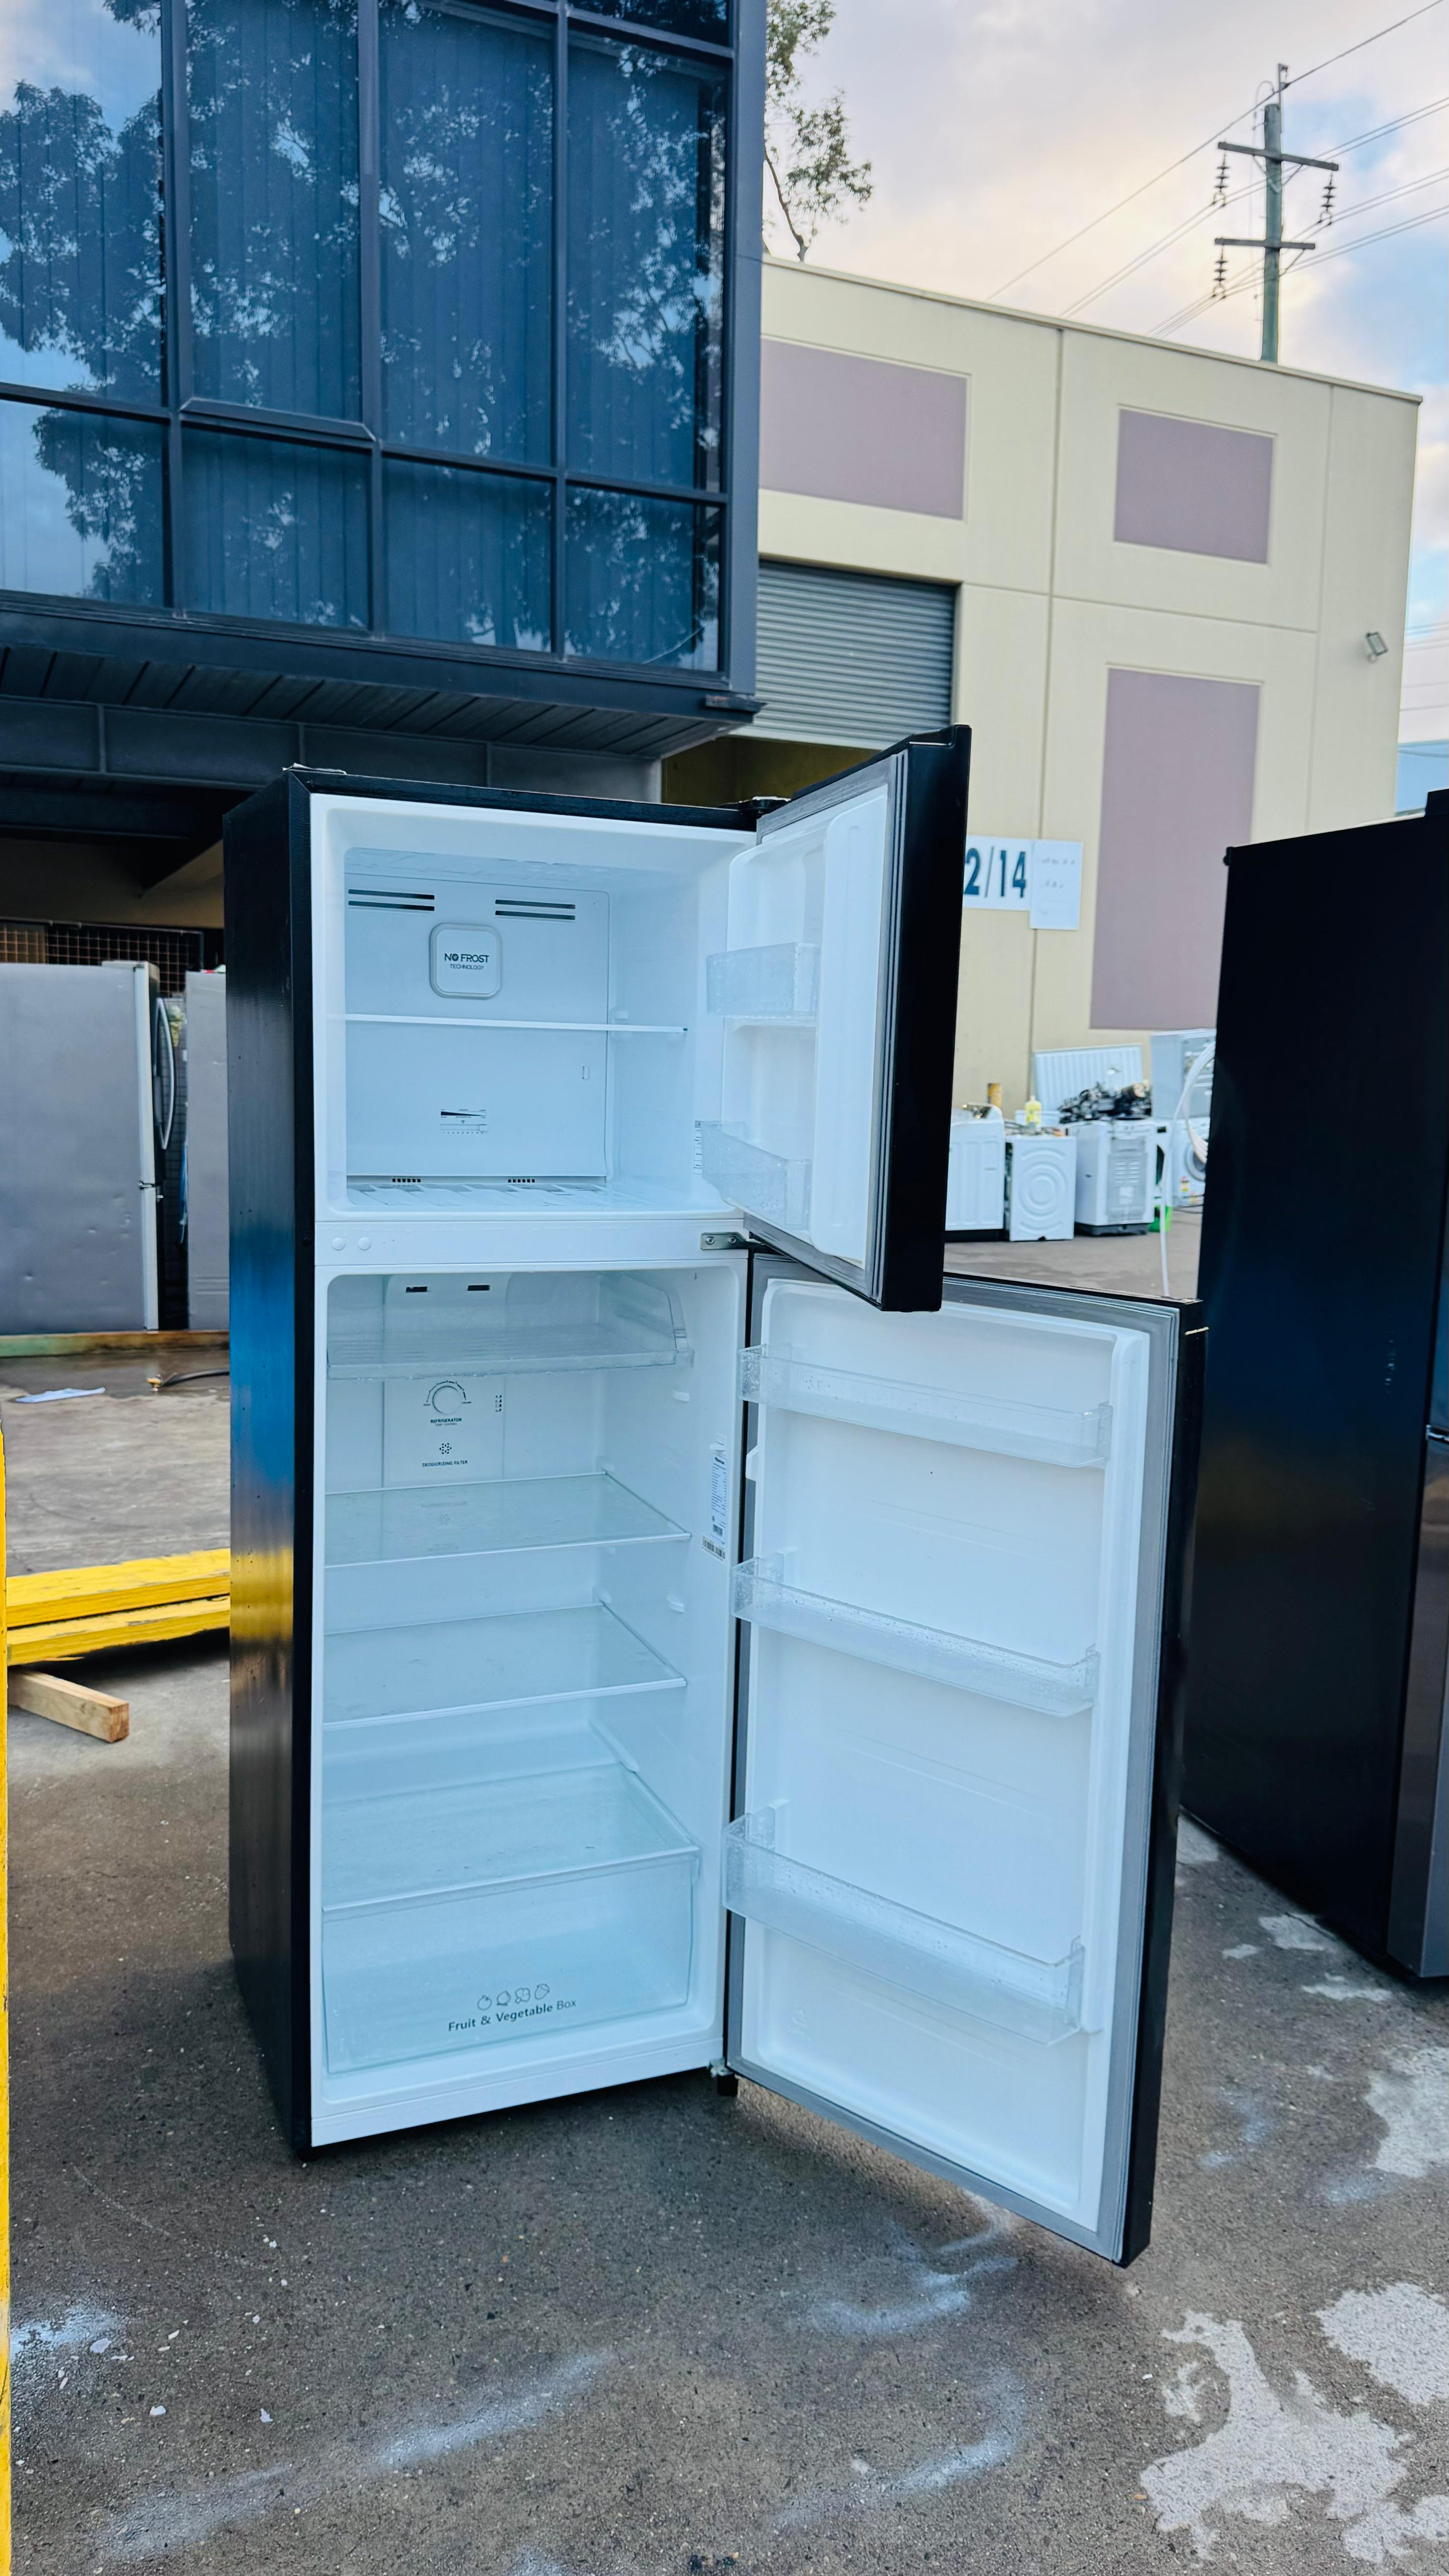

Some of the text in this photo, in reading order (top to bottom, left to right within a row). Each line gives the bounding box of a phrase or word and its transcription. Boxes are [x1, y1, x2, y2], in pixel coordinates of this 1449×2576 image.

[963, 845, 1026, 898] 2/14
[445, 953, 490, 962] NO FROST
[448, 1999, 578, 2032] Fruit & Vegetable Box
